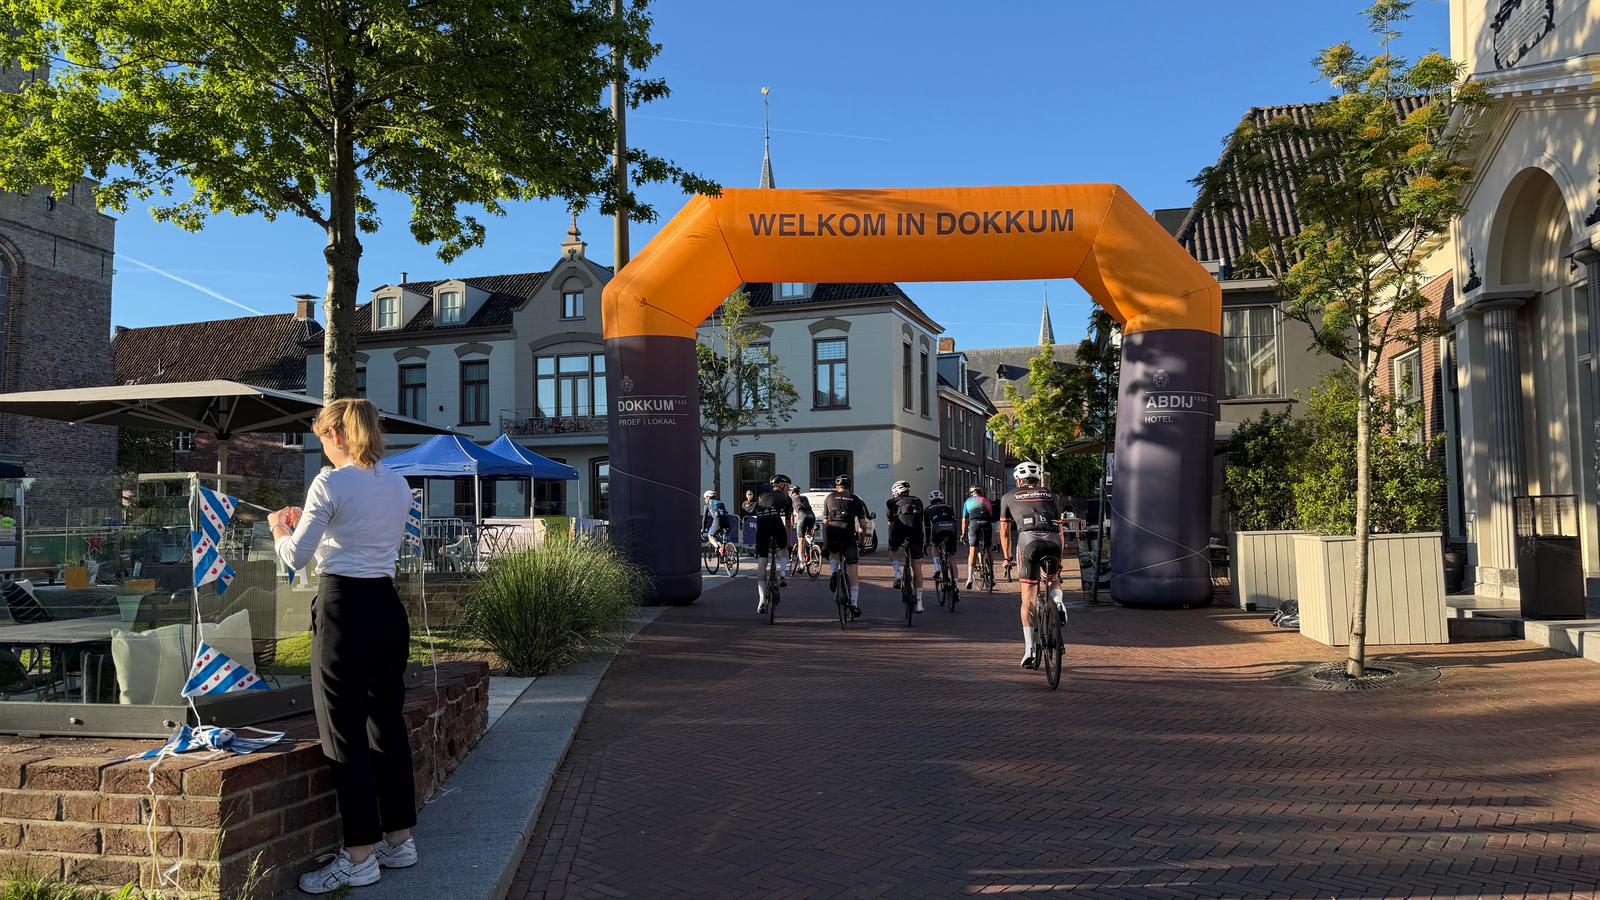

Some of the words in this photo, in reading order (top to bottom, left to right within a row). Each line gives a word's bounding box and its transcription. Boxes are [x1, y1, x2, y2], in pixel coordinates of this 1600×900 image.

[749, 213, 886, 236] WELKOM
[897, 213, 925, 235] IN
[936, 209, 1074, 235] DOKKUM
[617, 400, 674, 411] DOKKUM
[1145, 396, 1193, 408] ABDIJ
[1144, 415, 1174, 424] HOTEL
